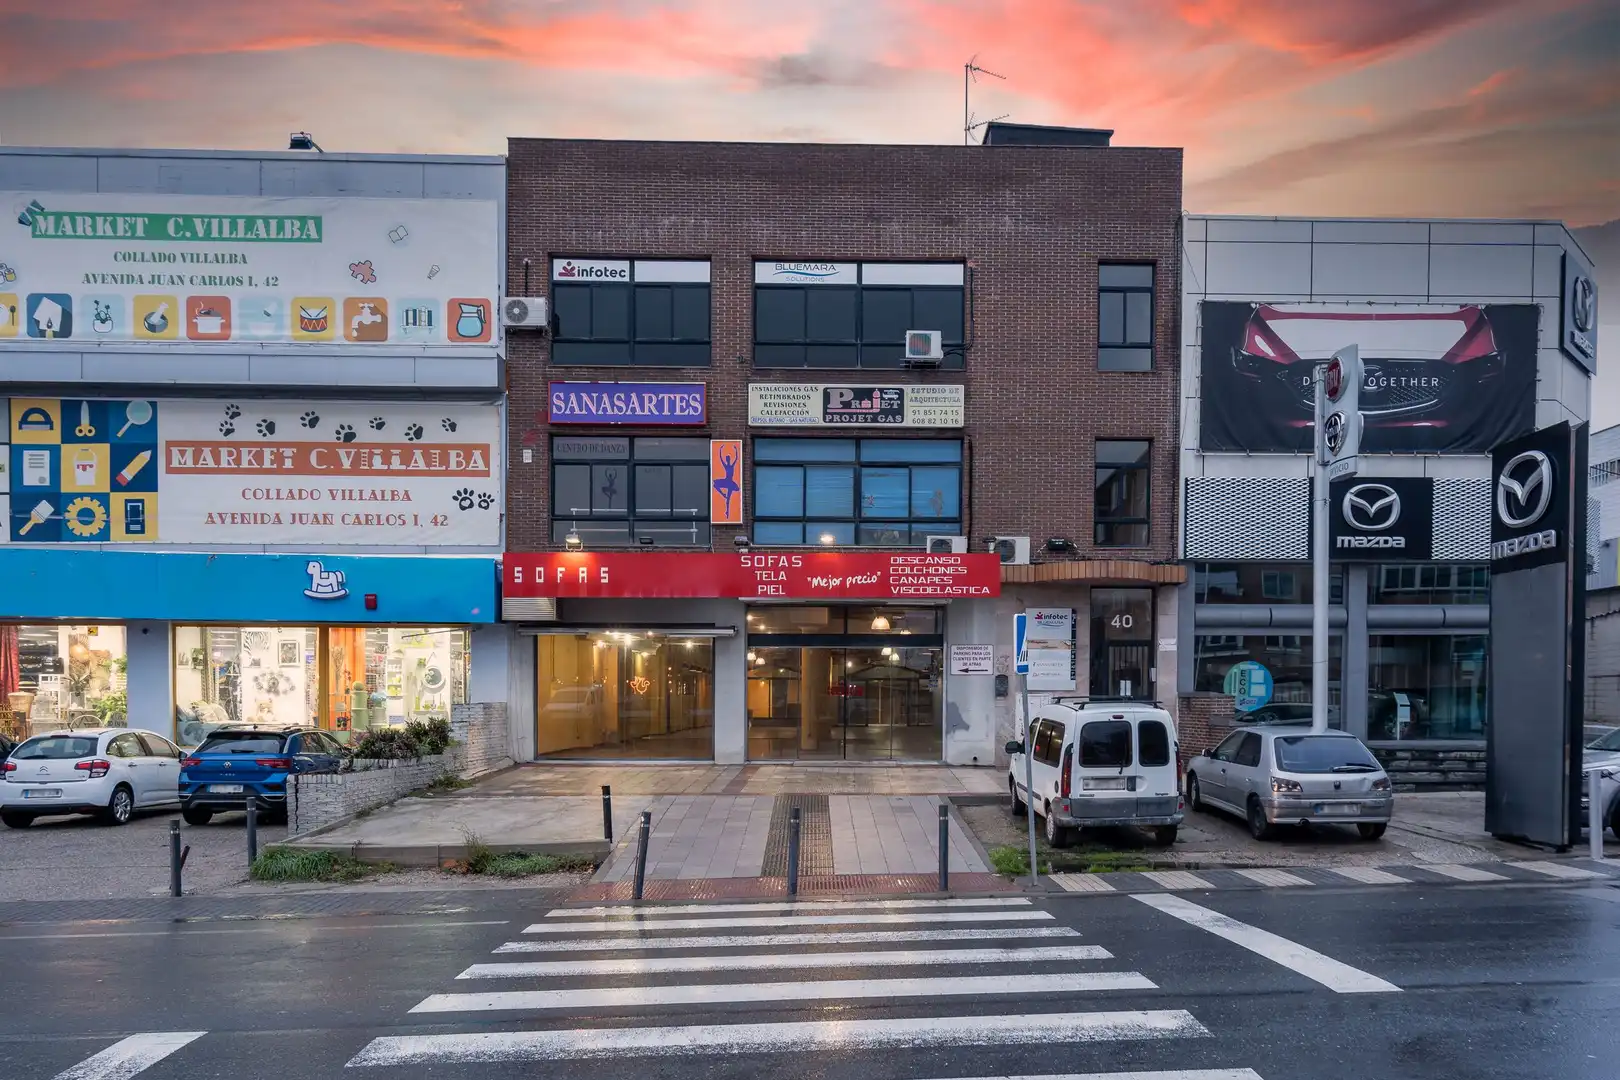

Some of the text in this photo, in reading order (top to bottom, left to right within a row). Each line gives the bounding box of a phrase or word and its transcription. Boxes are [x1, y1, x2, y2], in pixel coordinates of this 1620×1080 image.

[35, 215, 320, 239] MARKET C.VILLALBA
[113, 251, 248, 264] COLLADO VILLALBA
[577, 266, 626, 278] infotec
[775, 263, 837, 271] BLUEMARA
[82, 272, 144, 285] AVENIDA
[148, 274, 186, 286] JUAN
[189, 275, 244, 287] CARLOS
[263, 276, 279, 287] 42
[1361, 377, 1439, 387] OGETHER
[552, 392, 702, 416] SANASARTES
[825, 414, 902, 422] PROJET GAS
[169, 447, 489, 471] MARKET C.VILLALBA
[241, 488, 413, 502] COLLADO VILLALBA
[204, 512, 283, 525] AVENIDA
[289, 513, 334, 525] JUAN
[341, 513, 406, 526] CARLOS
[430, 514, 449, 527] 42
[1336, 536, 1406, 549] mazda
[1491, 529, 1557, 561] mazda
[740, 555, 803, 567] SOFAS
[890, 556, 961, 565] DESCANSO
[514, 566, 609, 584] SOFAS
[754, 570, 787, 581] TELA
[889, 566, 968, 575] COLCHONES
[889, 576, 953, 585] CANAPES
[757, 584, 786, 595] PIEL
[890, 586, 990, 594] VISCOELASTICA
[1110, 614, 1133, 628] 40
[1239, 669, 1247, 695] ECO
